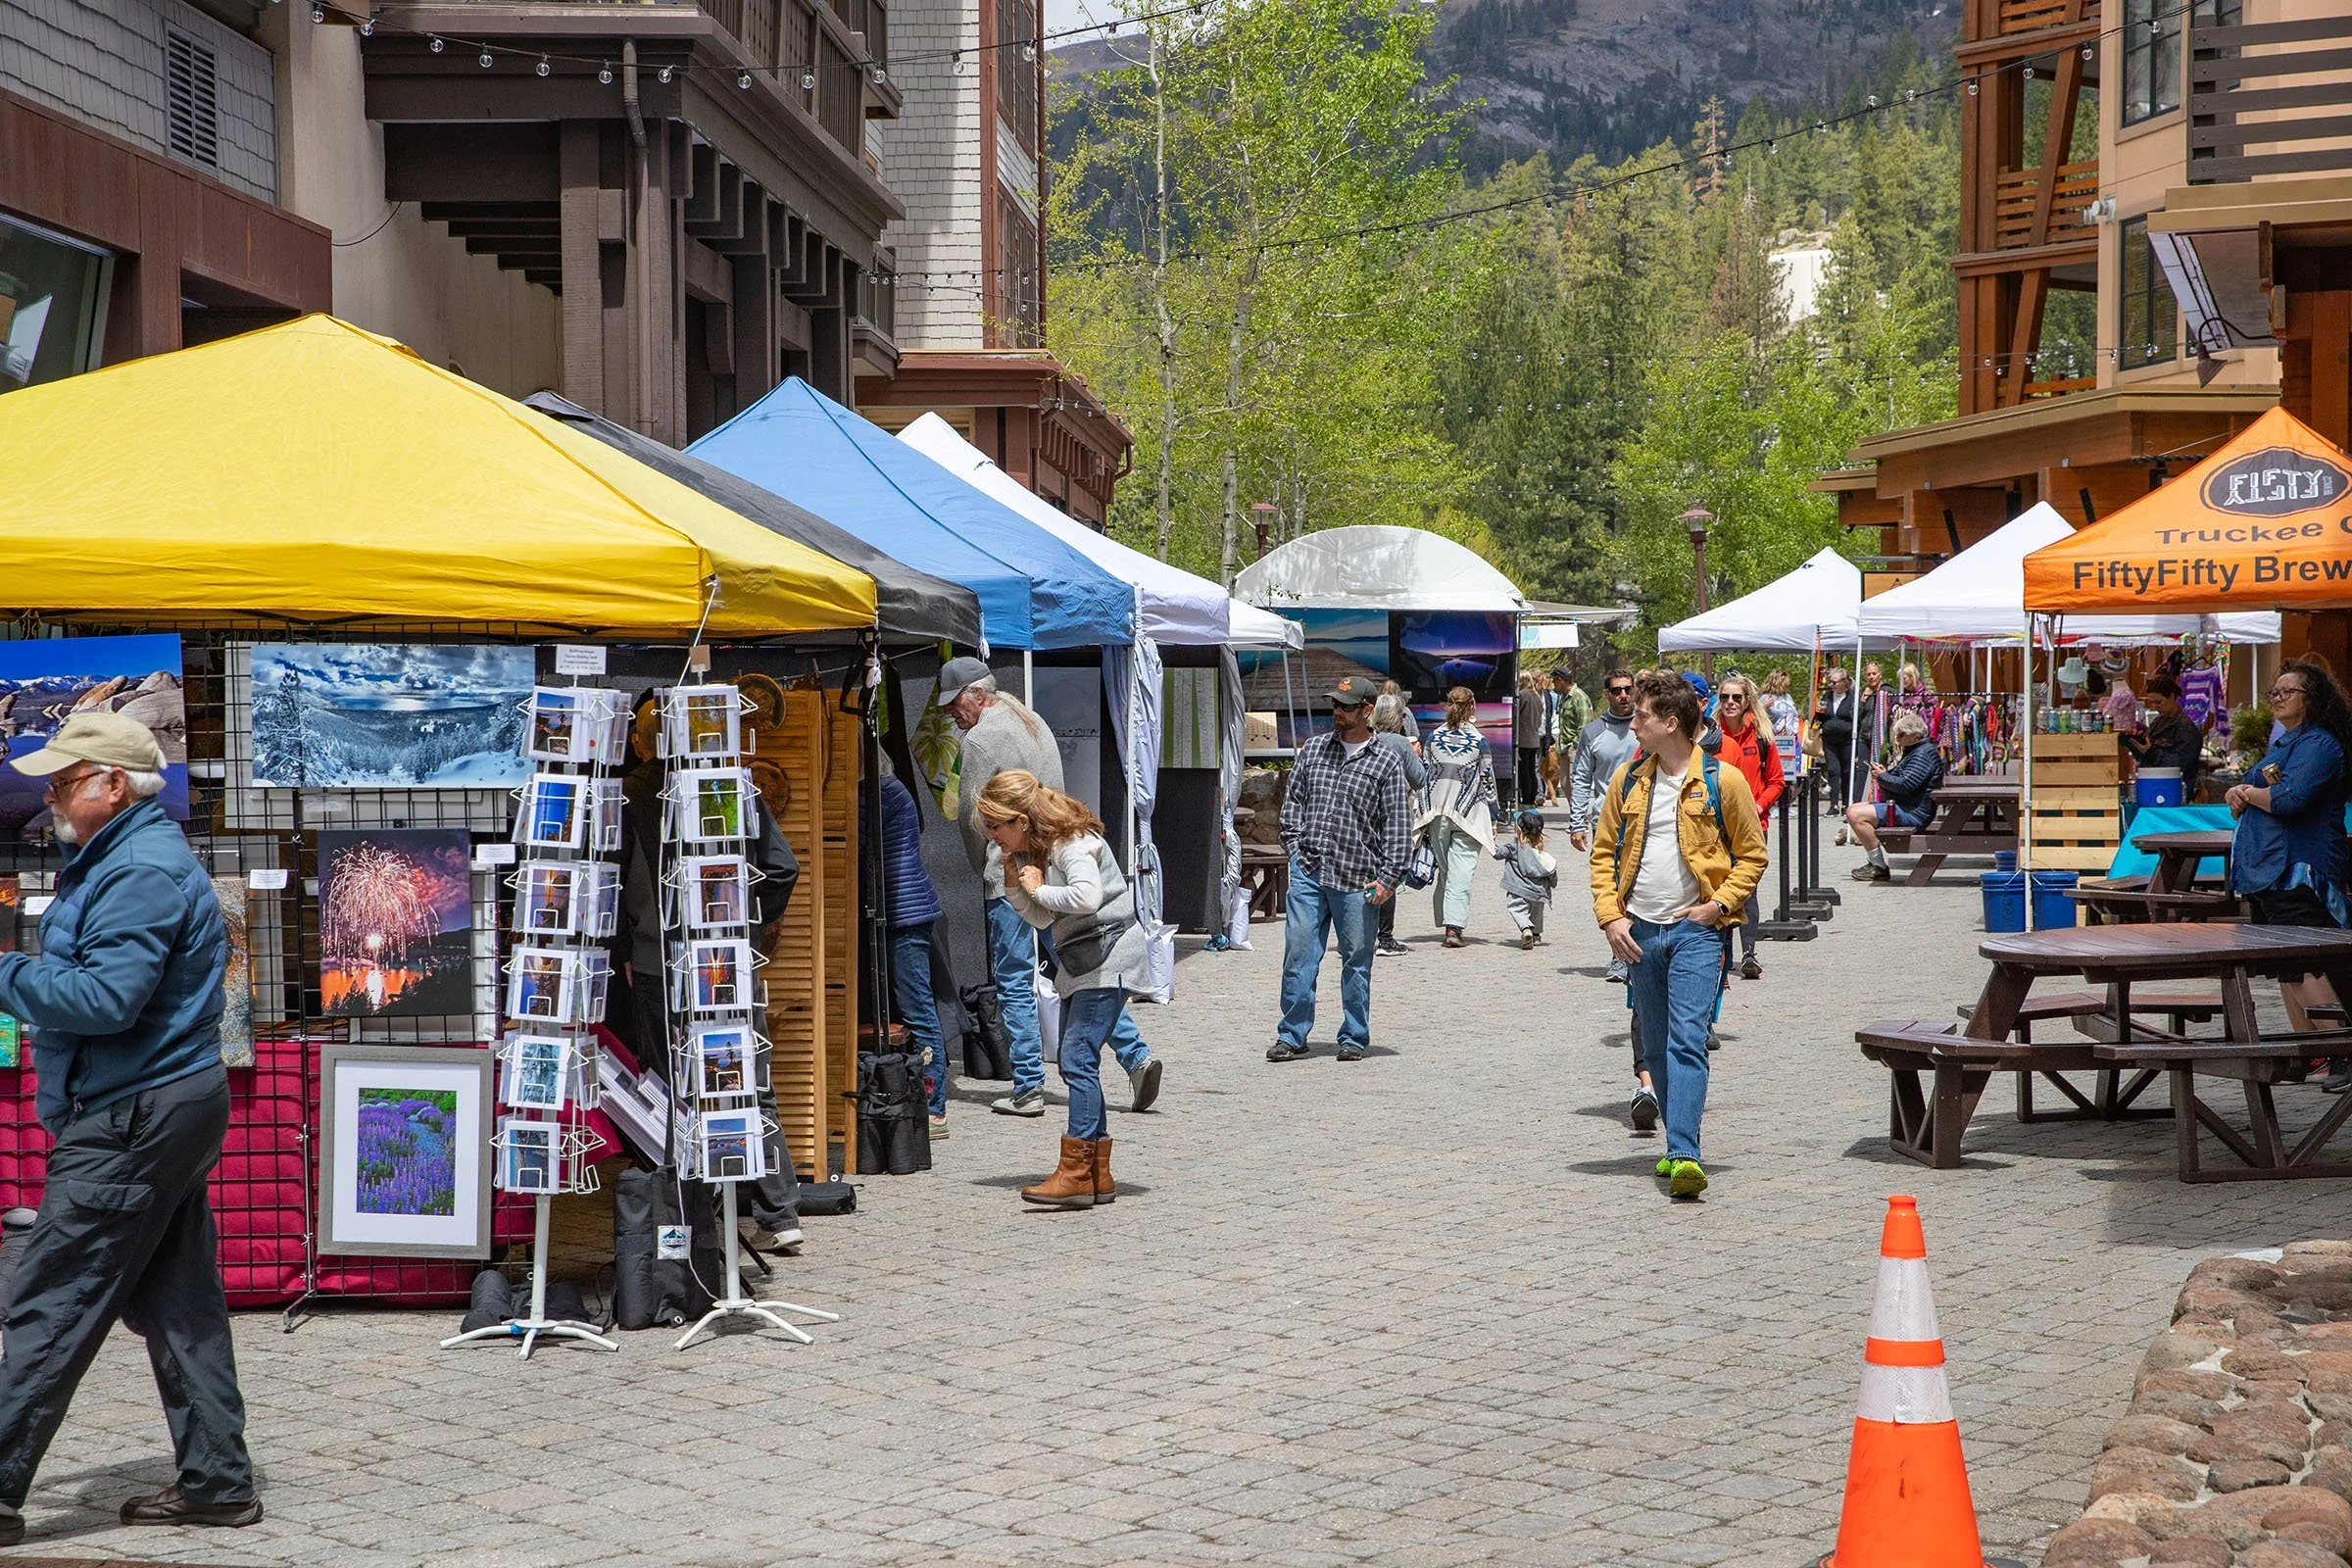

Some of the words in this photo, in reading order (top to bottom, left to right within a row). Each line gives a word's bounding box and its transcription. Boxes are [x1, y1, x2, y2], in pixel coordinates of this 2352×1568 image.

[2230, 468, 2324, 491] FIFTY
[2155, 522, 2324, 544] Truckee
[2074, 559, 2239, 594] FiftyFifty
